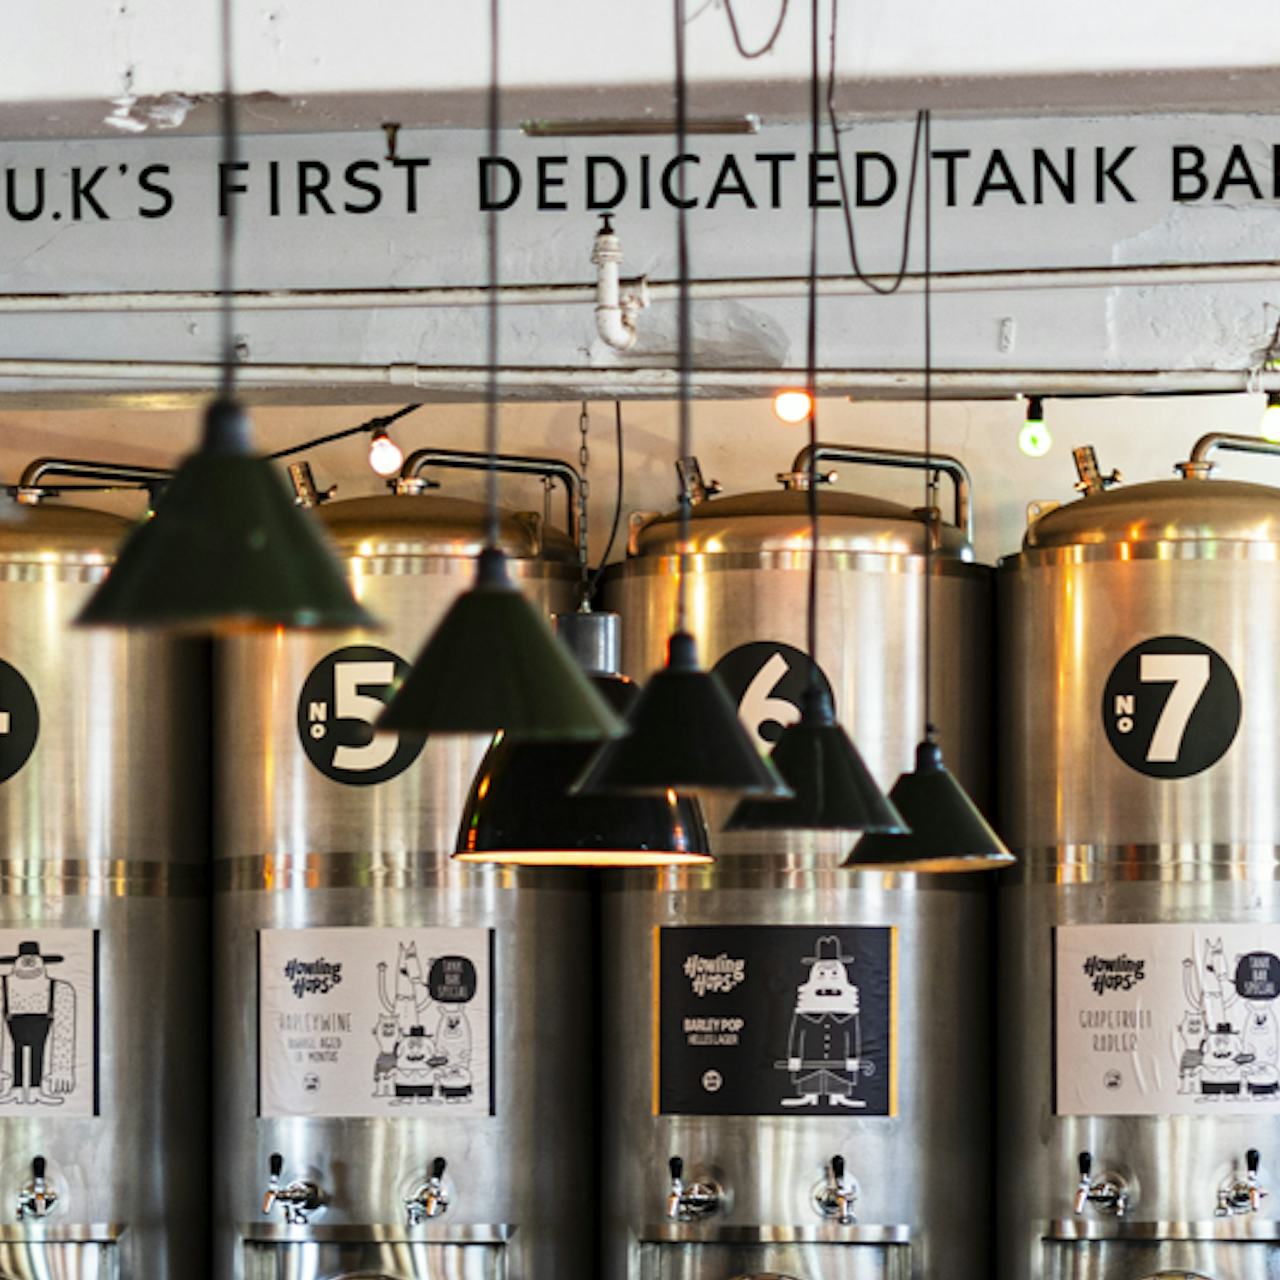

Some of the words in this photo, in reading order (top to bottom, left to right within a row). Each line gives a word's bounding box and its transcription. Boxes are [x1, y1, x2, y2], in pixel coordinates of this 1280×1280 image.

[4, 162, 175, 222] U.K'S
[218, 156, 431, 218] FIRST
[477, 150, 899, 213] DEDICATED
[932, 145, 1138, 207] TANK
[331, 660, 402, 772] 5
[1139, 653, 1211, 763] 7
[284, 957, 342, 984] Howling
[683, 953, 745, 982] Howling
[1083, 953, 1145, 981] Howling
[720, 1017, 745, 1032] POP
